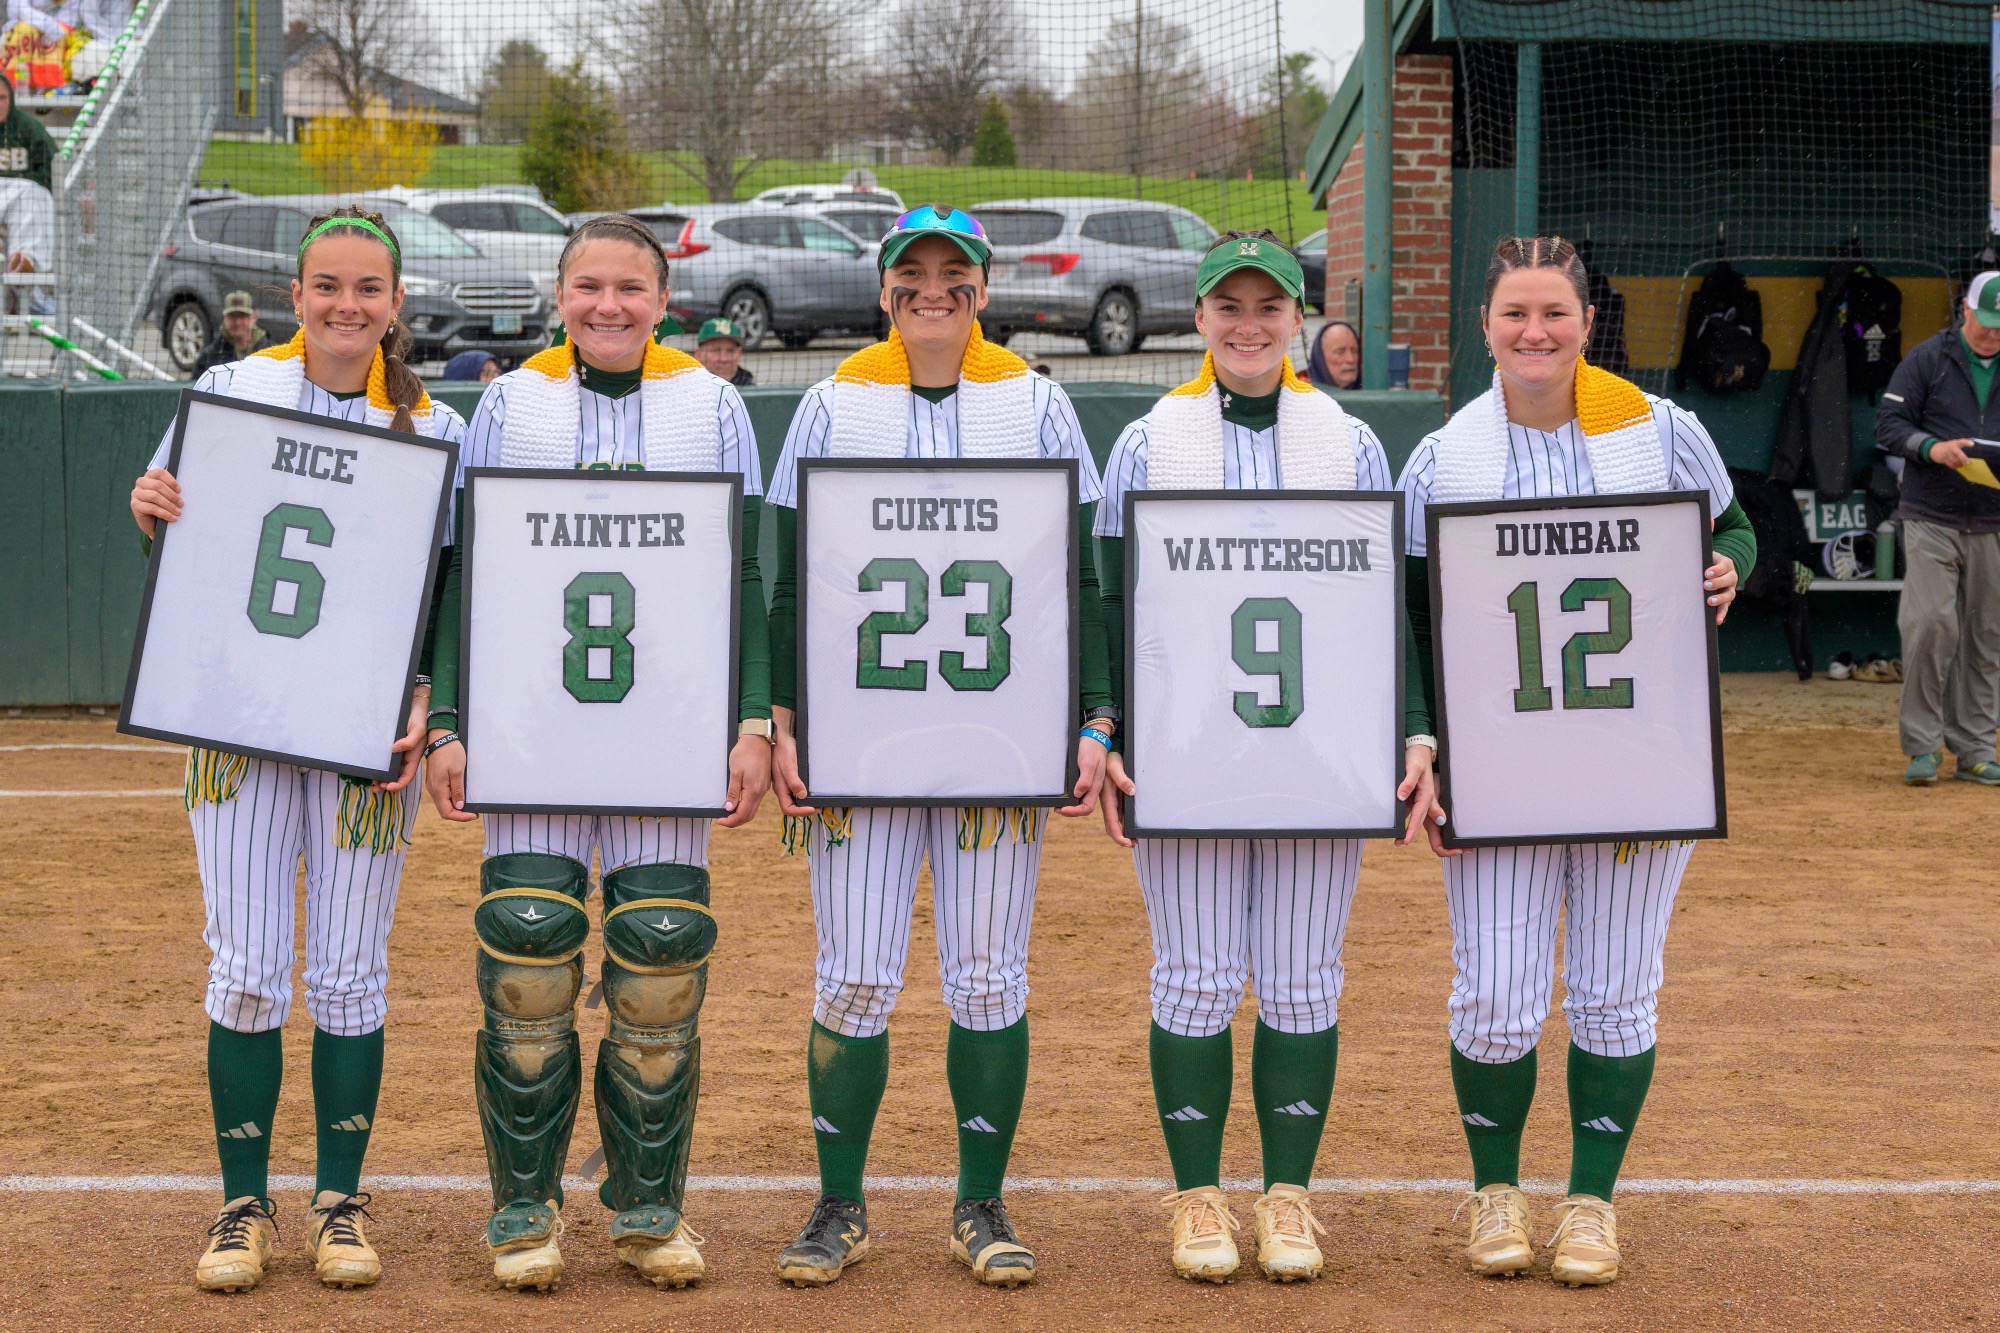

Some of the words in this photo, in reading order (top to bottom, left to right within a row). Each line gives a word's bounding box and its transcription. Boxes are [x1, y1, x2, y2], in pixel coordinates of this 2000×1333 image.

[271, 436, 358, 485] RICE
[526, 512, 685, 548] TAINTER
[872, 497, 998, 532] CURTIS
[1163, 537, 1372, 572] WATTERSON
[1495, 518, 1641, 557] DUNBAR
[246, 502, 336, 640] 6
[562, 571, 636, 704] 8
[856, 557, 1013, 692] 23
[1230, 596, 1305, 729] 9
[1506, 577, 1634, 713] 12
